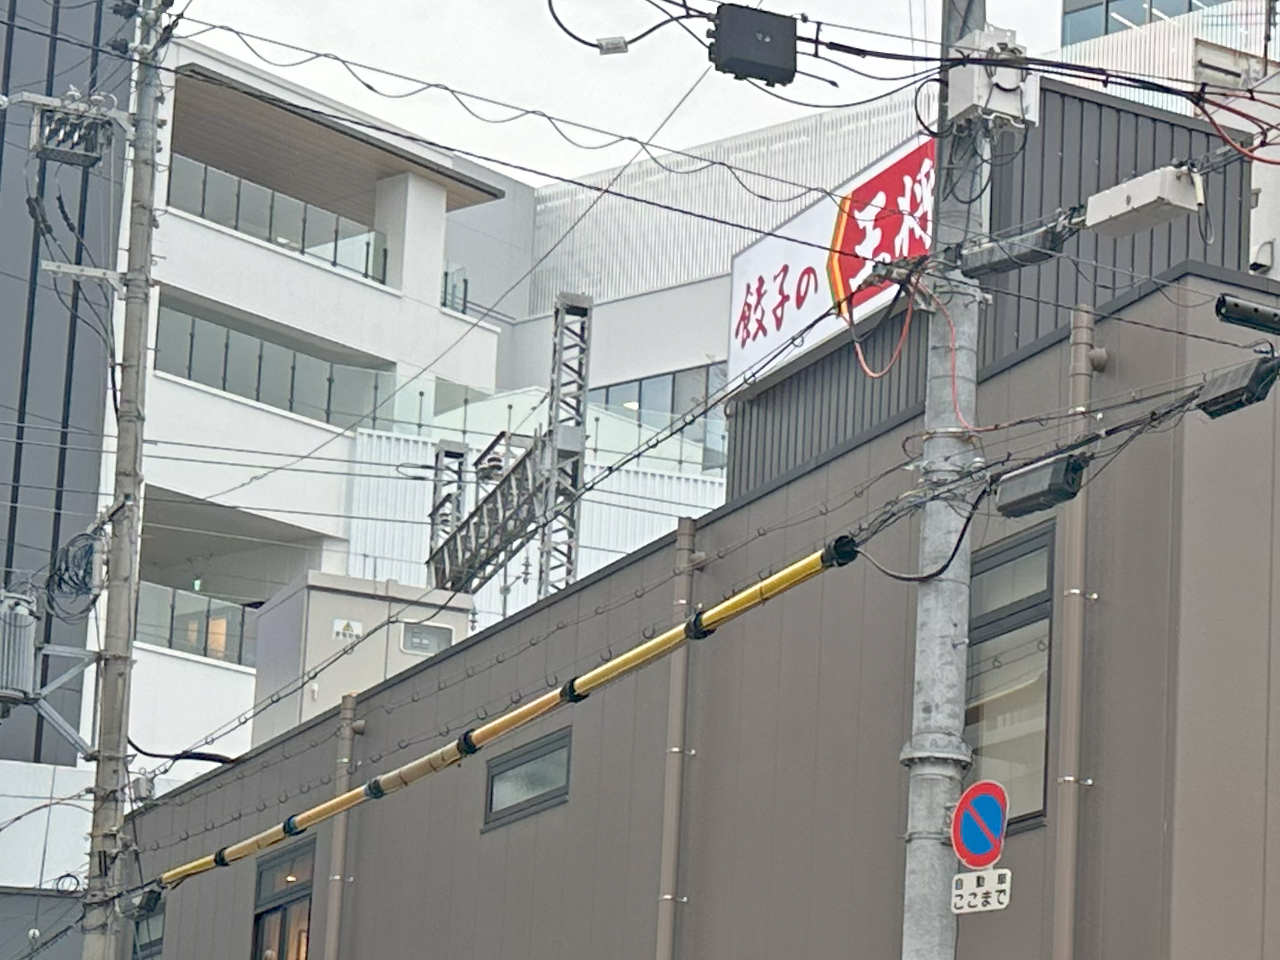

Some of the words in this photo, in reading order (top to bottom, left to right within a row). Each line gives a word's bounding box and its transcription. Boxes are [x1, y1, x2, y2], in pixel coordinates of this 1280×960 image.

[735, 264, 818, 348] 餃子の
[953, 889, 1007, 910] ここまで
